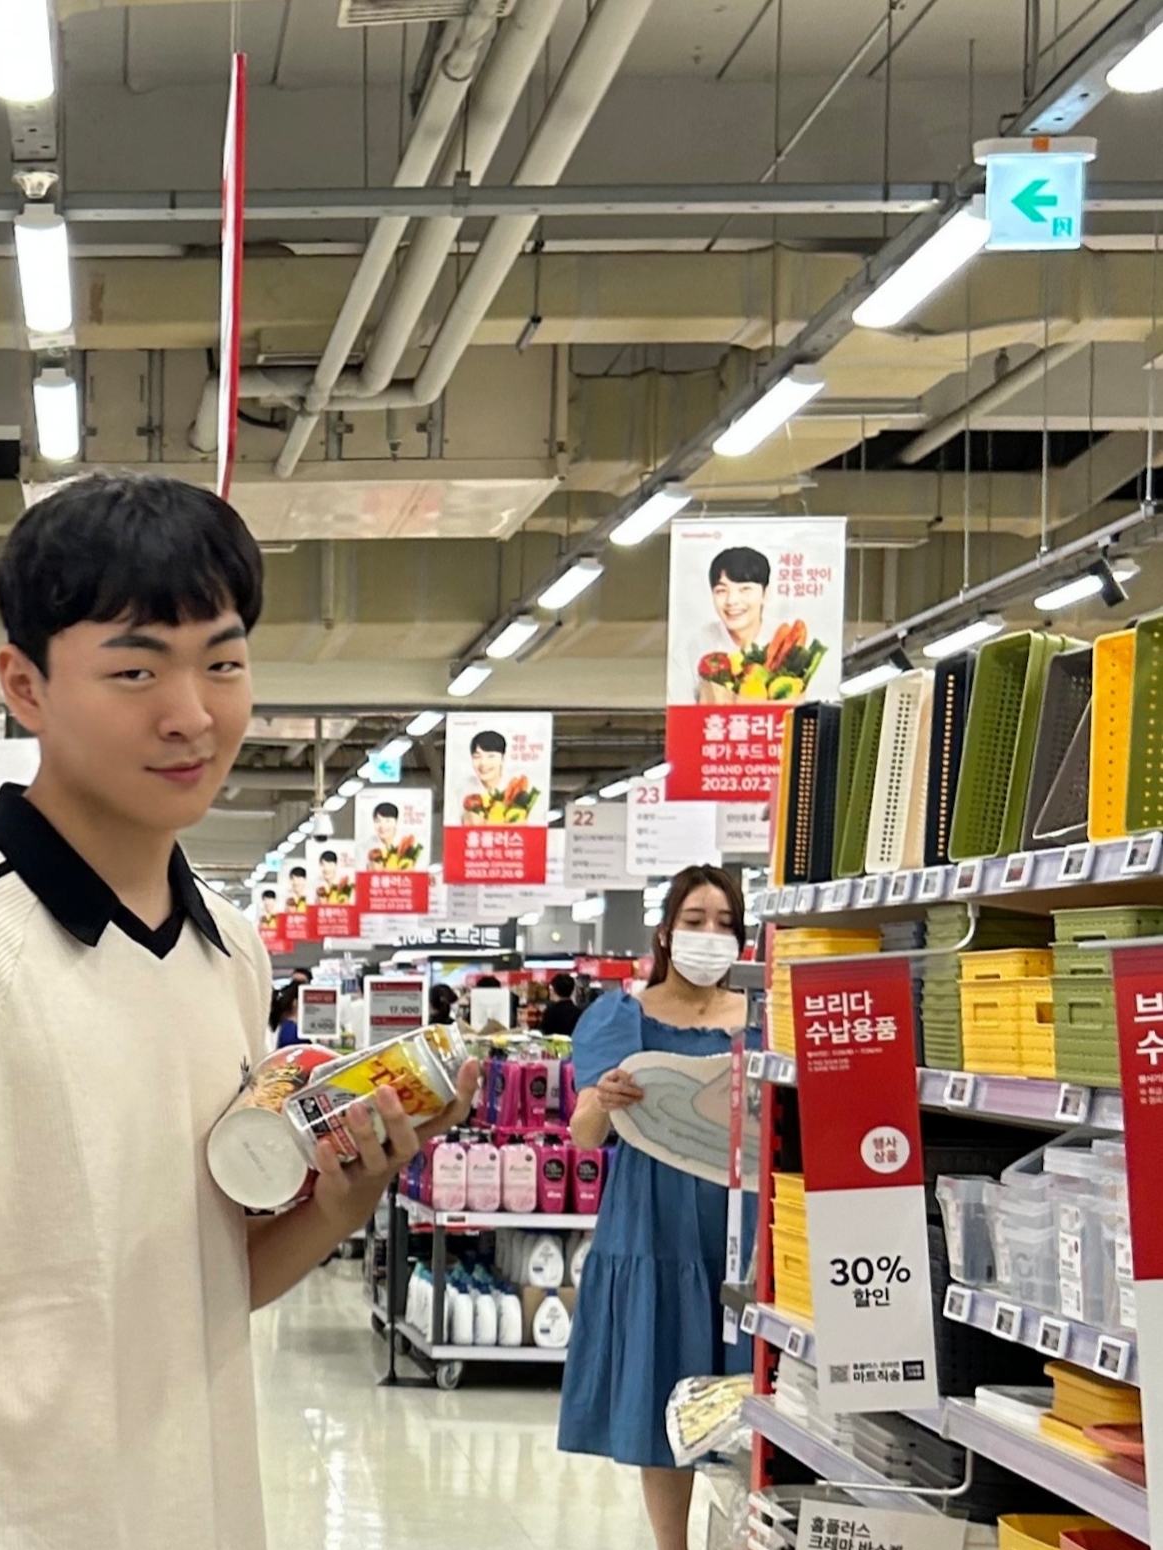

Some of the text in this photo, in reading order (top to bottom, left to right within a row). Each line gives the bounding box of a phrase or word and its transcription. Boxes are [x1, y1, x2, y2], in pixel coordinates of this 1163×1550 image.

[778, 553, 804, 566] 세상
[777, 567, 832, 583] 모든 맛이
[778, 582, 824, 598] 다 있다!
[702, 743, 732, 759] 메가
[735, 743, 765, 760] 푸드
[701, 764, 743, 776] GRAND
[701, 777, 772, 792] 2023.07.2
[635, 786, 660, 804] 23
[572, 810, 594, 827] 22
[465, 830, 524, 849] 홈플러스
[803, 990, 874, 1017] 브리다
[804, 1016, 898, 1046] 수납용품
[873, 1135, 898, 1150] 행사
[874, 1150, 899, 1164] 상품
[829, 1255, 911, 1287] 30%
[853, 1287, 891, 1309] 할인
[853, 1369, 901, 1385] 마트직송
[810, 1515, 871, 1539] 홈플러스
